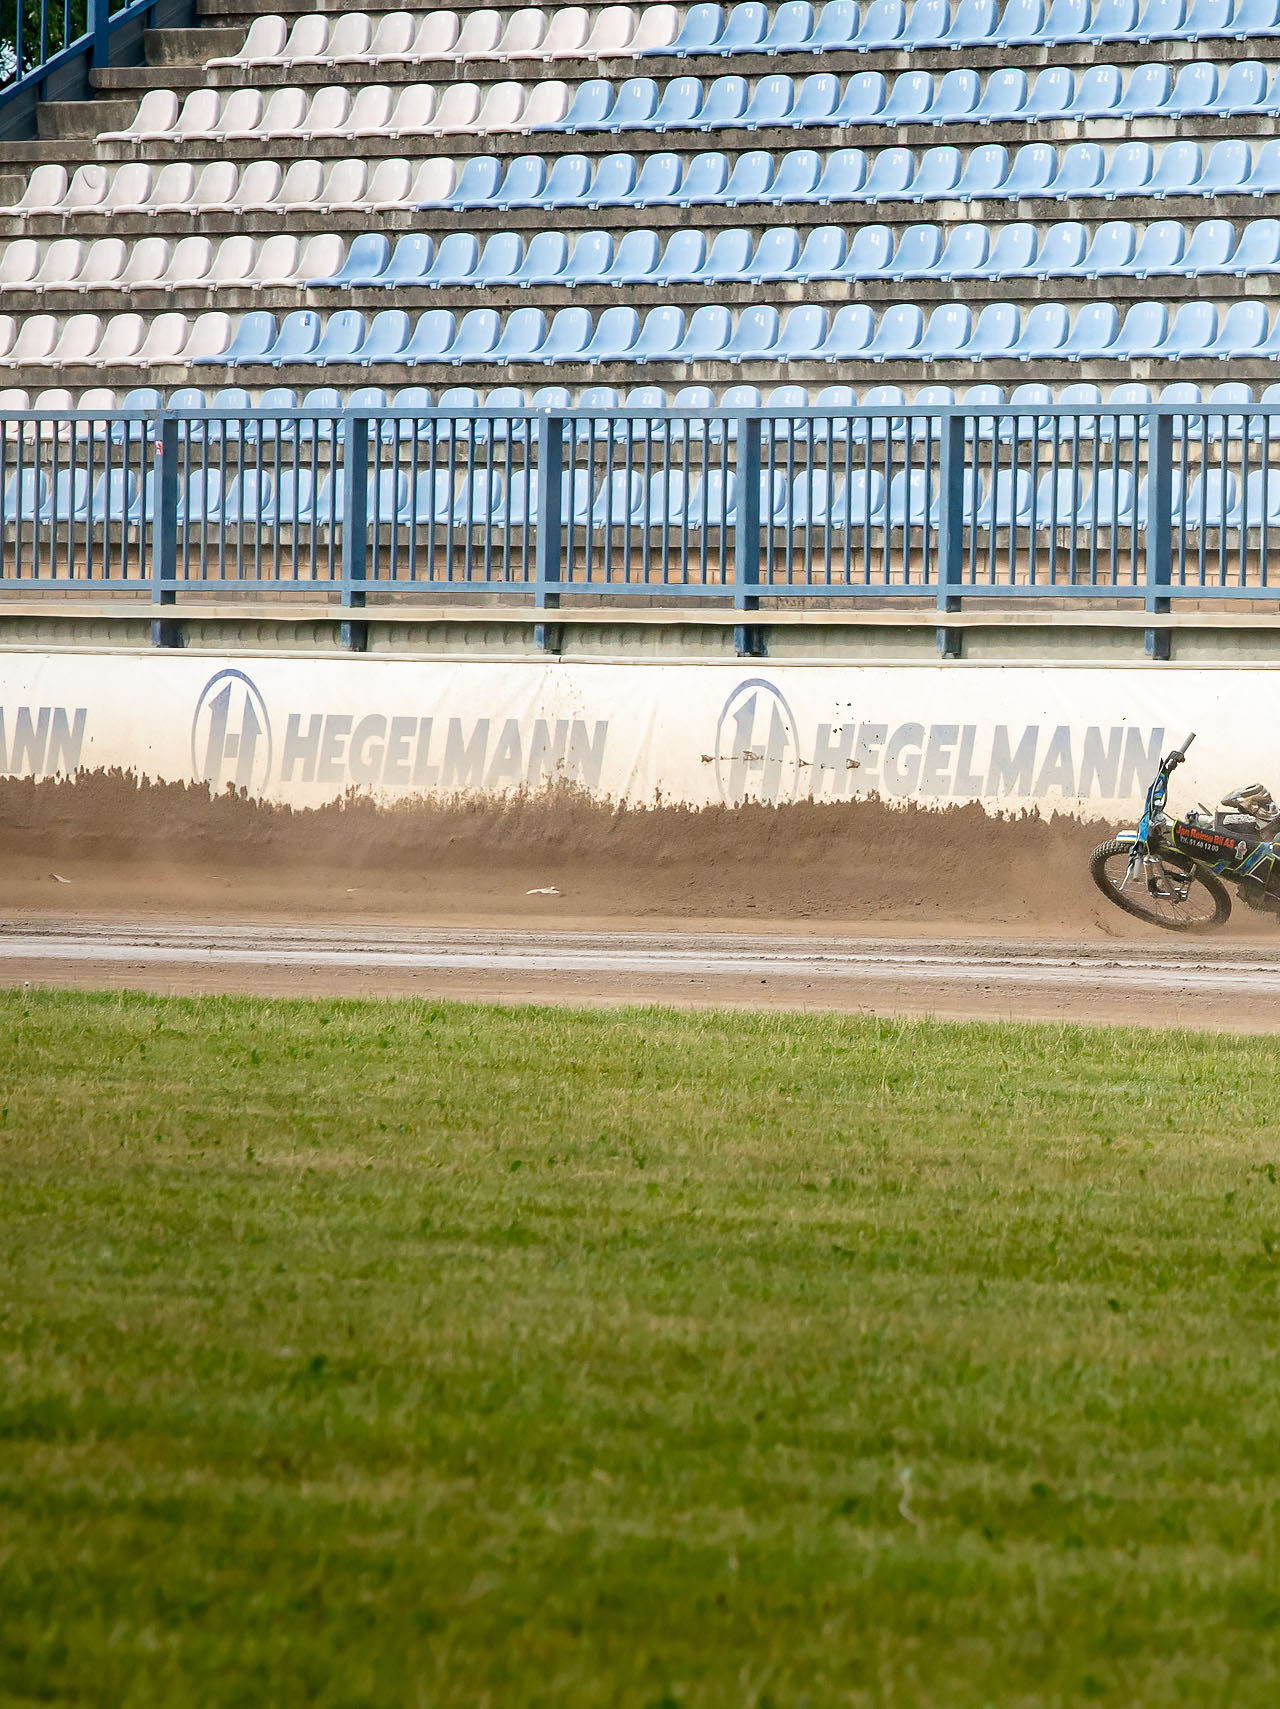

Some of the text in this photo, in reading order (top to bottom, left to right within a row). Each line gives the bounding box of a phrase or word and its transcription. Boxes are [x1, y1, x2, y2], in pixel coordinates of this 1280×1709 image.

[0, 706, 87, 774] NN
[281, 713, 609, 786] HEGELMANN
[813, 722, 1165, 799] HEGELMANN
